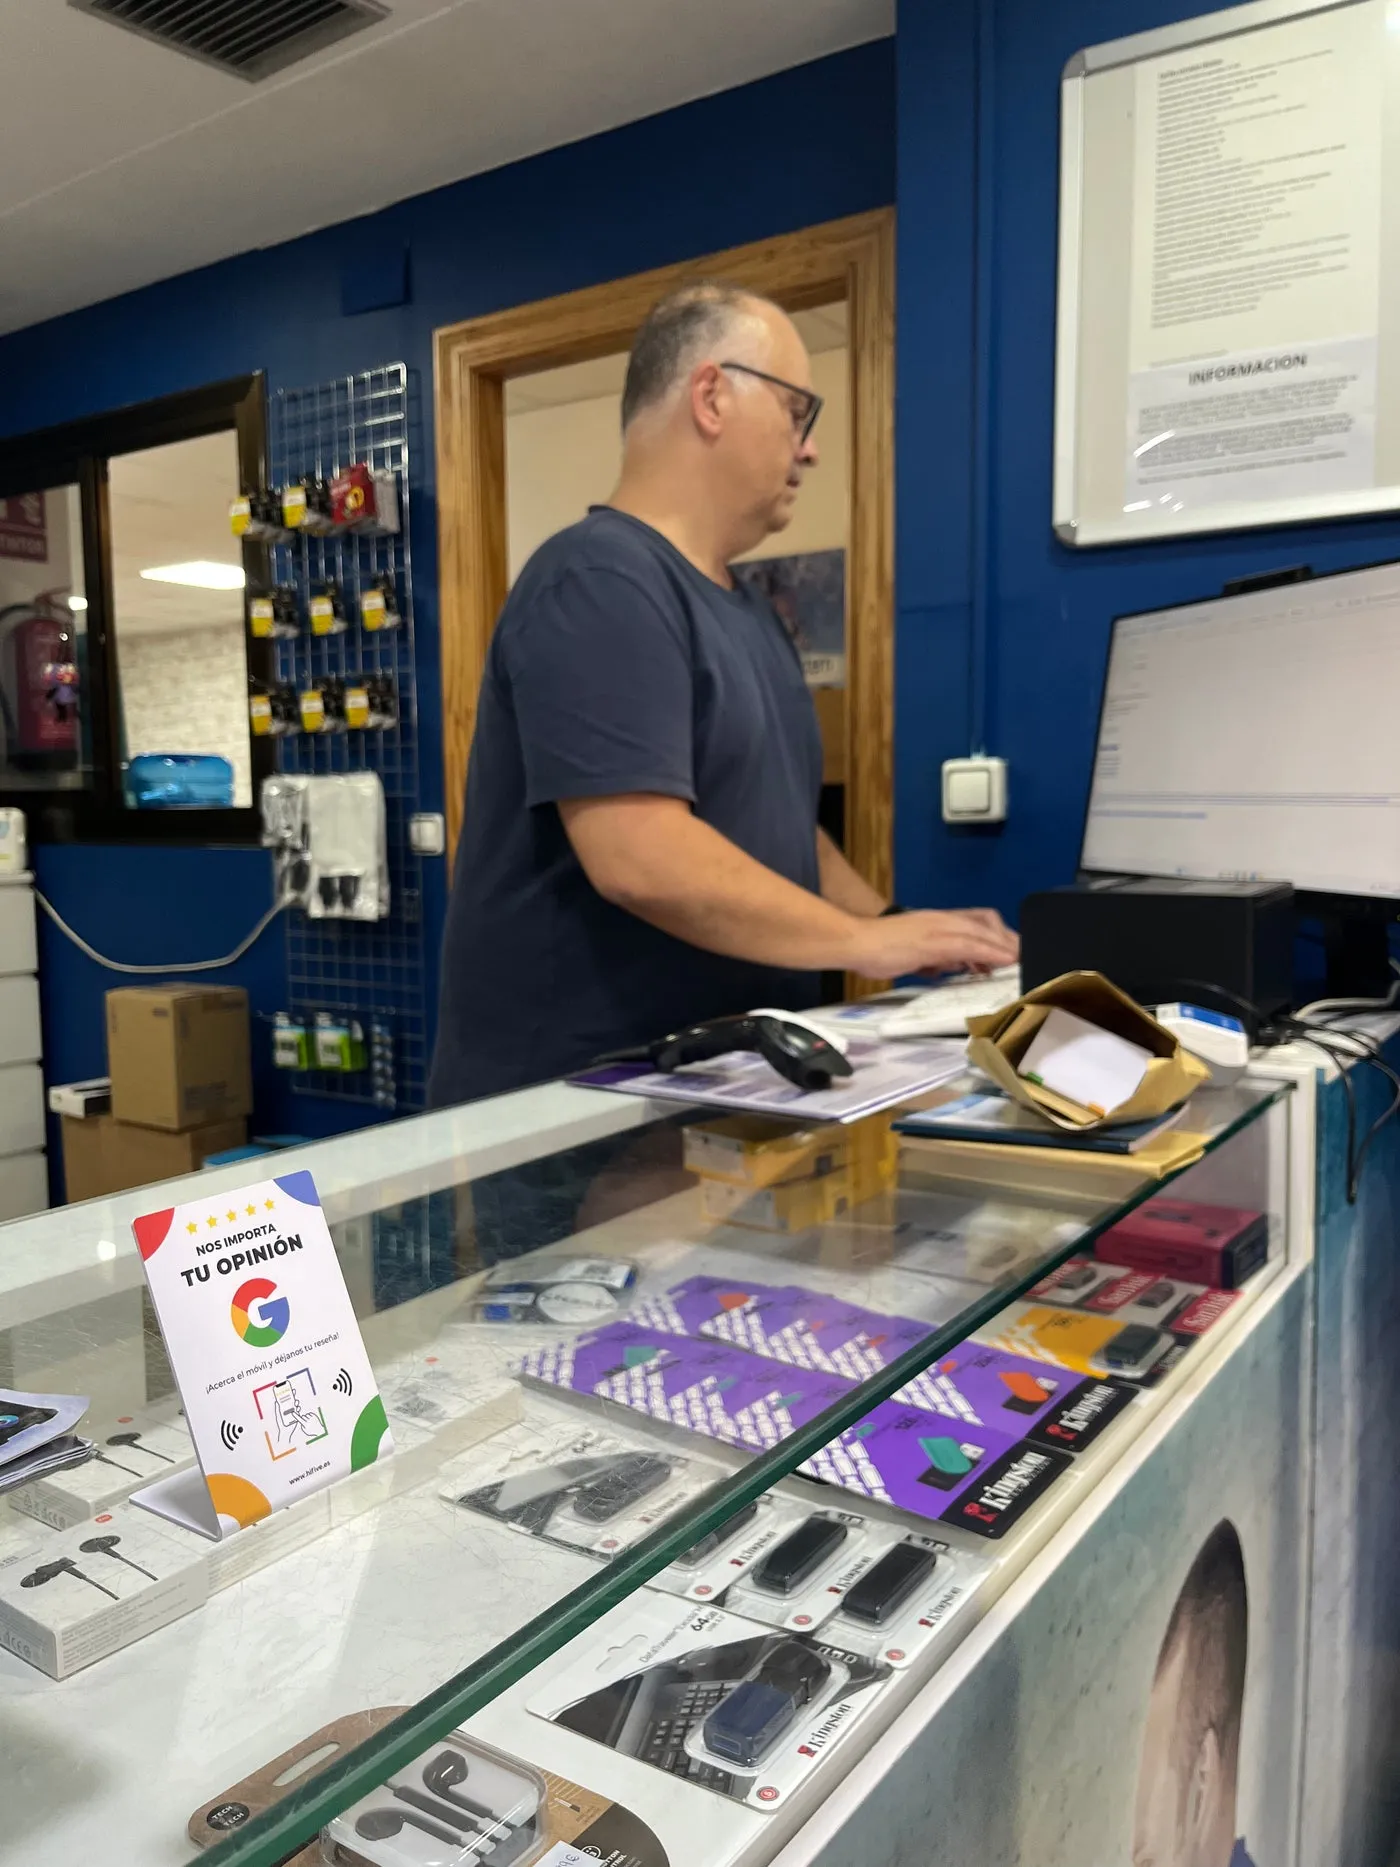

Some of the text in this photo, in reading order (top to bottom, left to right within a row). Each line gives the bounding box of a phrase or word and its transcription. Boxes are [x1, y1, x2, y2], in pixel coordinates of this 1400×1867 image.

[1188, 354, 1308, 386] INFORMACION
[180, 1234, 304, 1287] TU OPINIÓN
[195, 1223, 277, 1257] NOS IMPORTA
[205, 1331, 340, 1395] ¡Acerca el móvil y déjanos tu reseña!
[1059, 1384, 1115, 1432] Kingston
[288, 1459, 331, 1486] www.hifive.es
[979, 1451, 1049, 1511] Kingston
[927, 1585, 963, 1628] Kingston
[808, 1703, 852, 1749] Kingston
